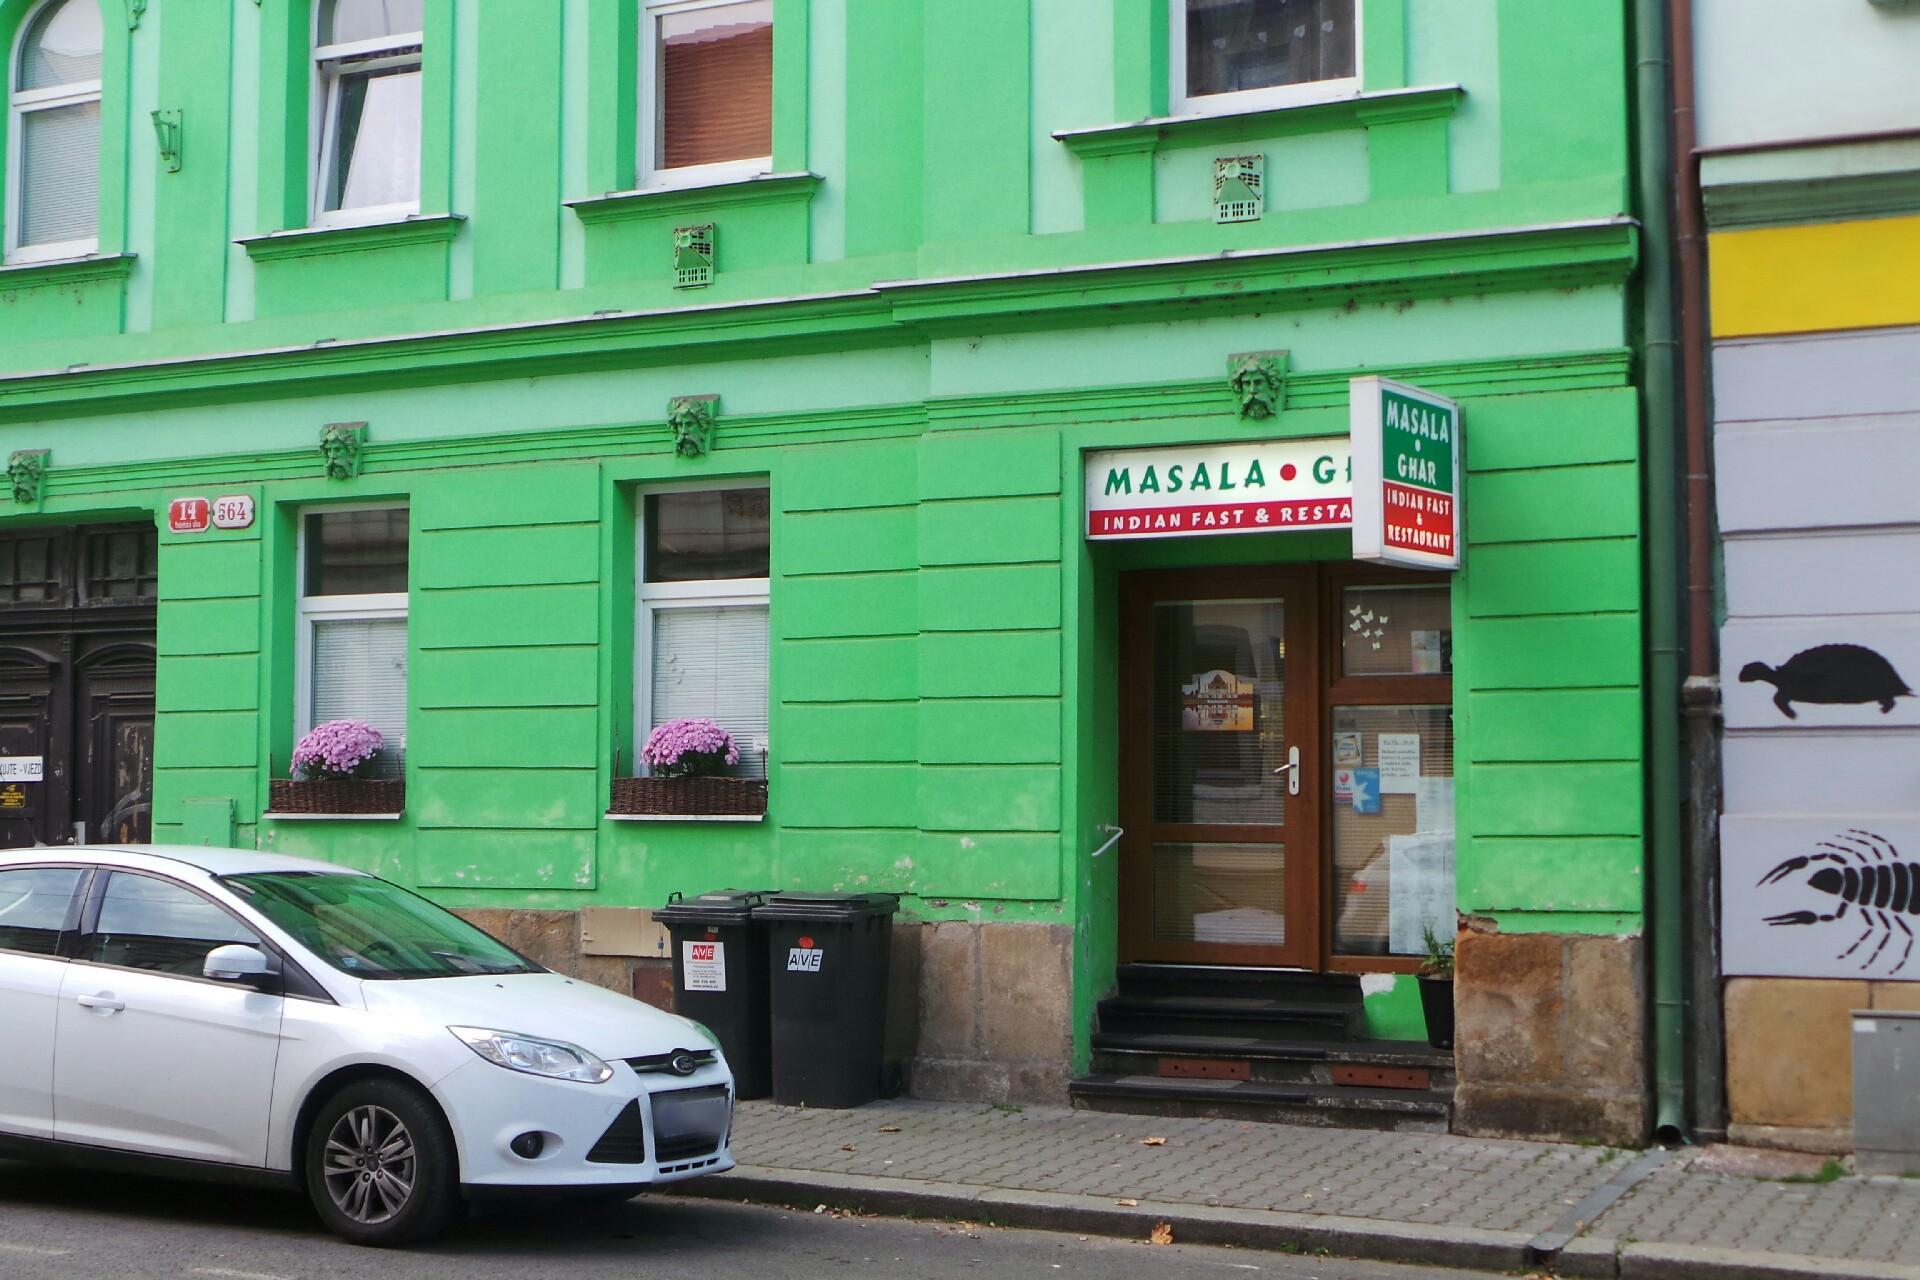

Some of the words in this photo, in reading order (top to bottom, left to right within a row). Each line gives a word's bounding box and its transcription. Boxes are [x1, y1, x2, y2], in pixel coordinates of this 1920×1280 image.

[1386, 399, 1449, 443] MASALA
[1104, 459, 1266, 496] MASALA
[1397, 453, 1436, 486] GHAR
[180, 501, 197, 521] 14
[218, 502, 246, 521] 564
[1387, 487, 1424, 510] INDIAN
[1426, 497, 1450, 516] FAST
[1104, 512, 1182, 531] INDIAN
[1191, 508, 1245, 527] FAST
[1255, 507, 1270, 524] &
[1416, 513, 1423, 526] &
[1387, 524, 1451, 550] RESTAURANT
[692, 947, 714, 958] AVE
[788, 954, 821, 967] AVE
